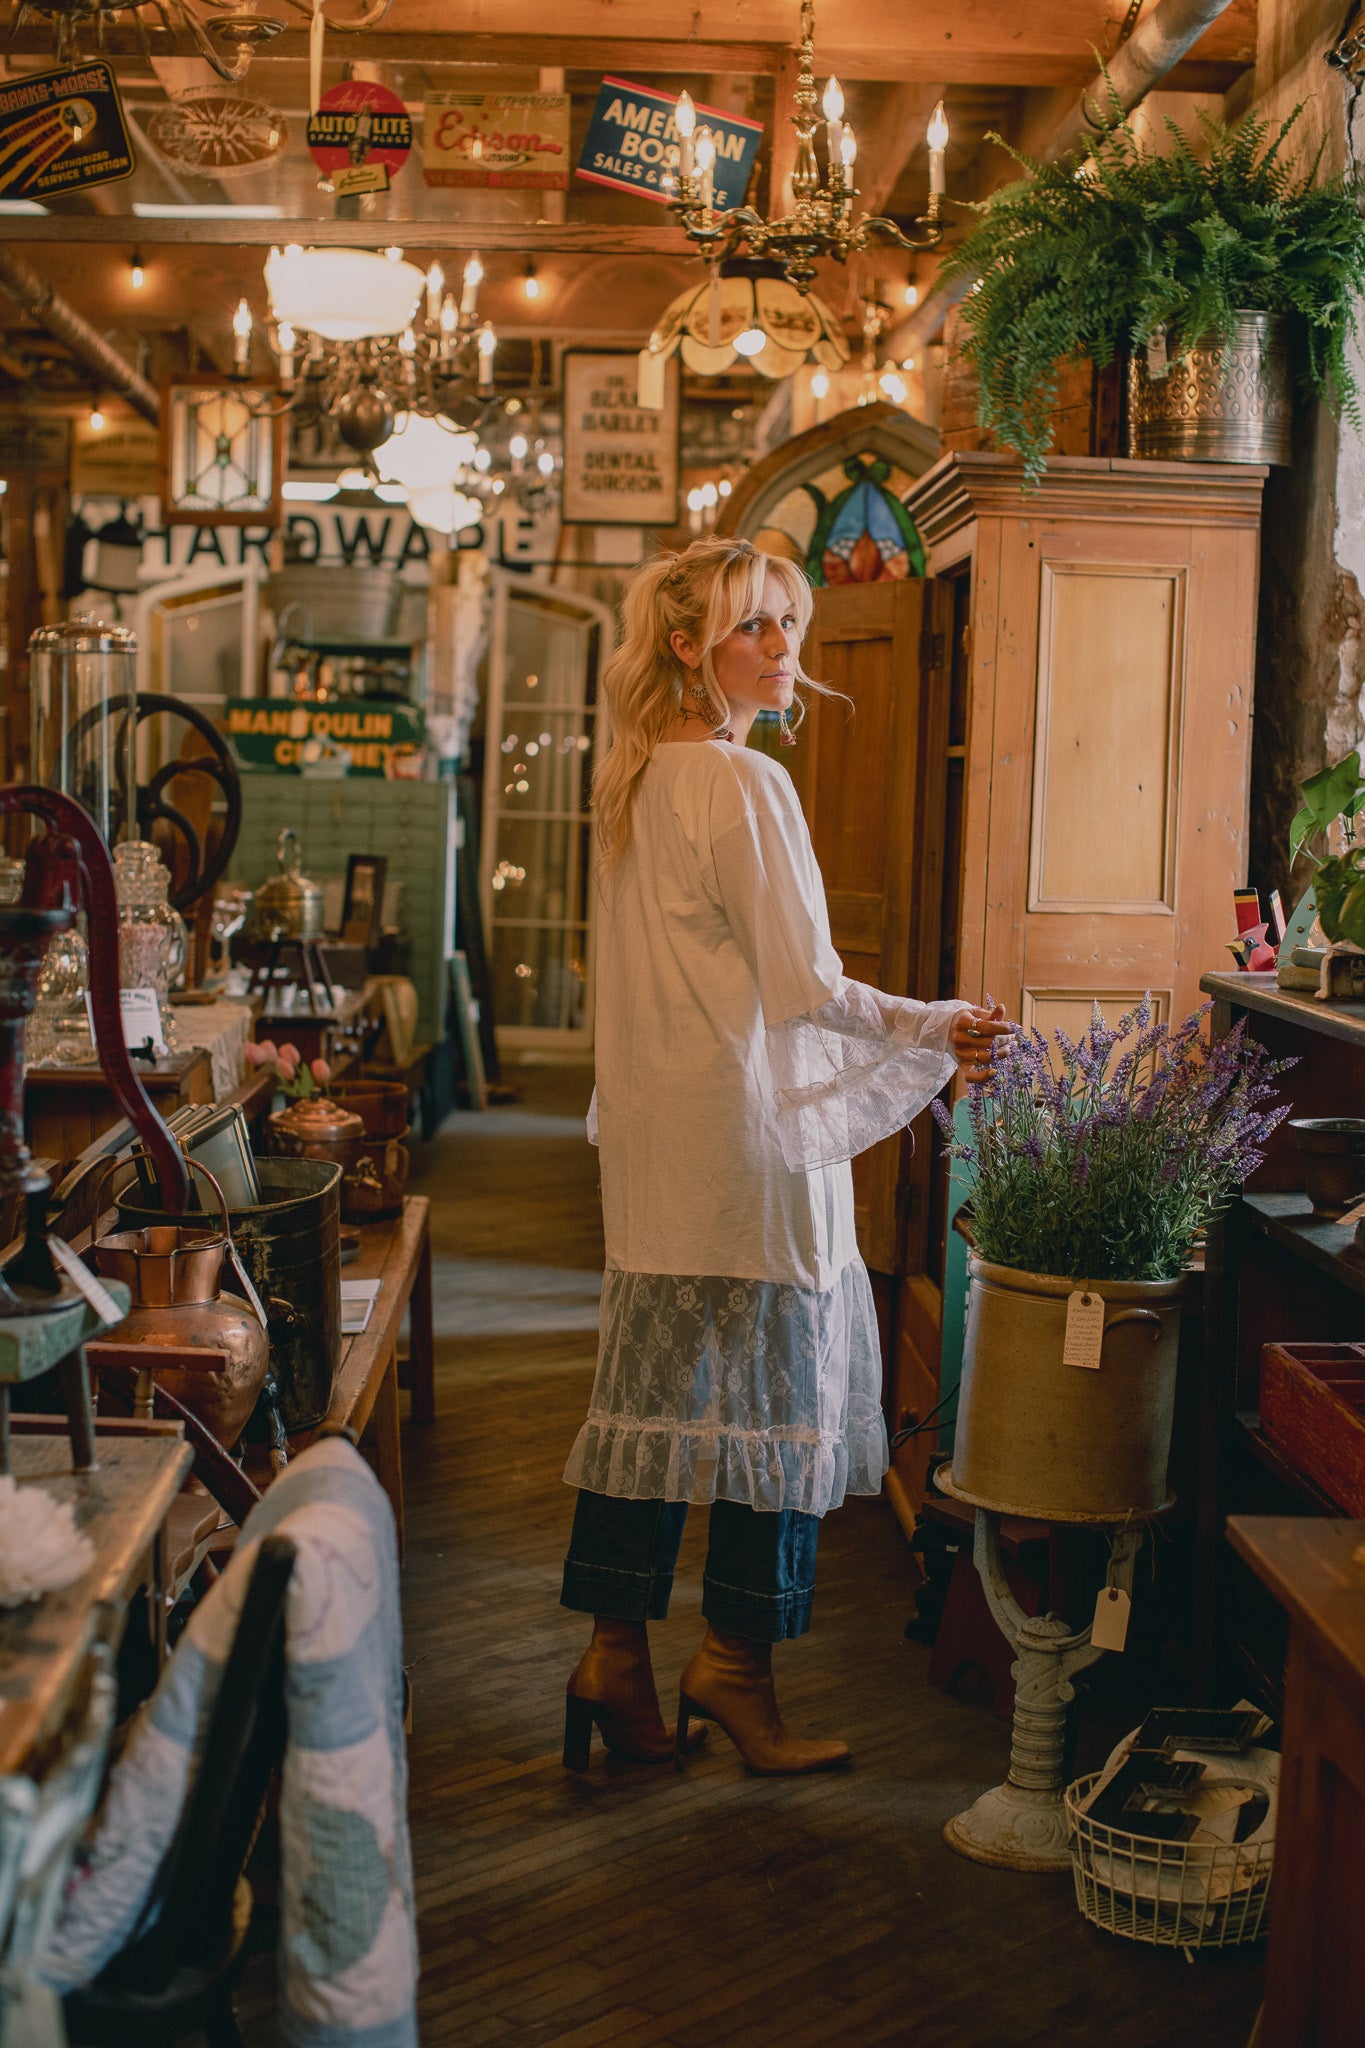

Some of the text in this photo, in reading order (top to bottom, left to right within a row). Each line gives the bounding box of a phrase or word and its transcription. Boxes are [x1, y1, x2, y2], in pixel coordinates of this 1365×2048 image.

[308, 115, 411, 135] AUTO LITE
[602, 98, 747, 162] AMERAN
[619, 130, 686, 170] BOS
[37, 168, 80, 188] SERVICE
[593, 152, 657, 184] SALES &
[229, 708, 393, 739] MANOULIN
